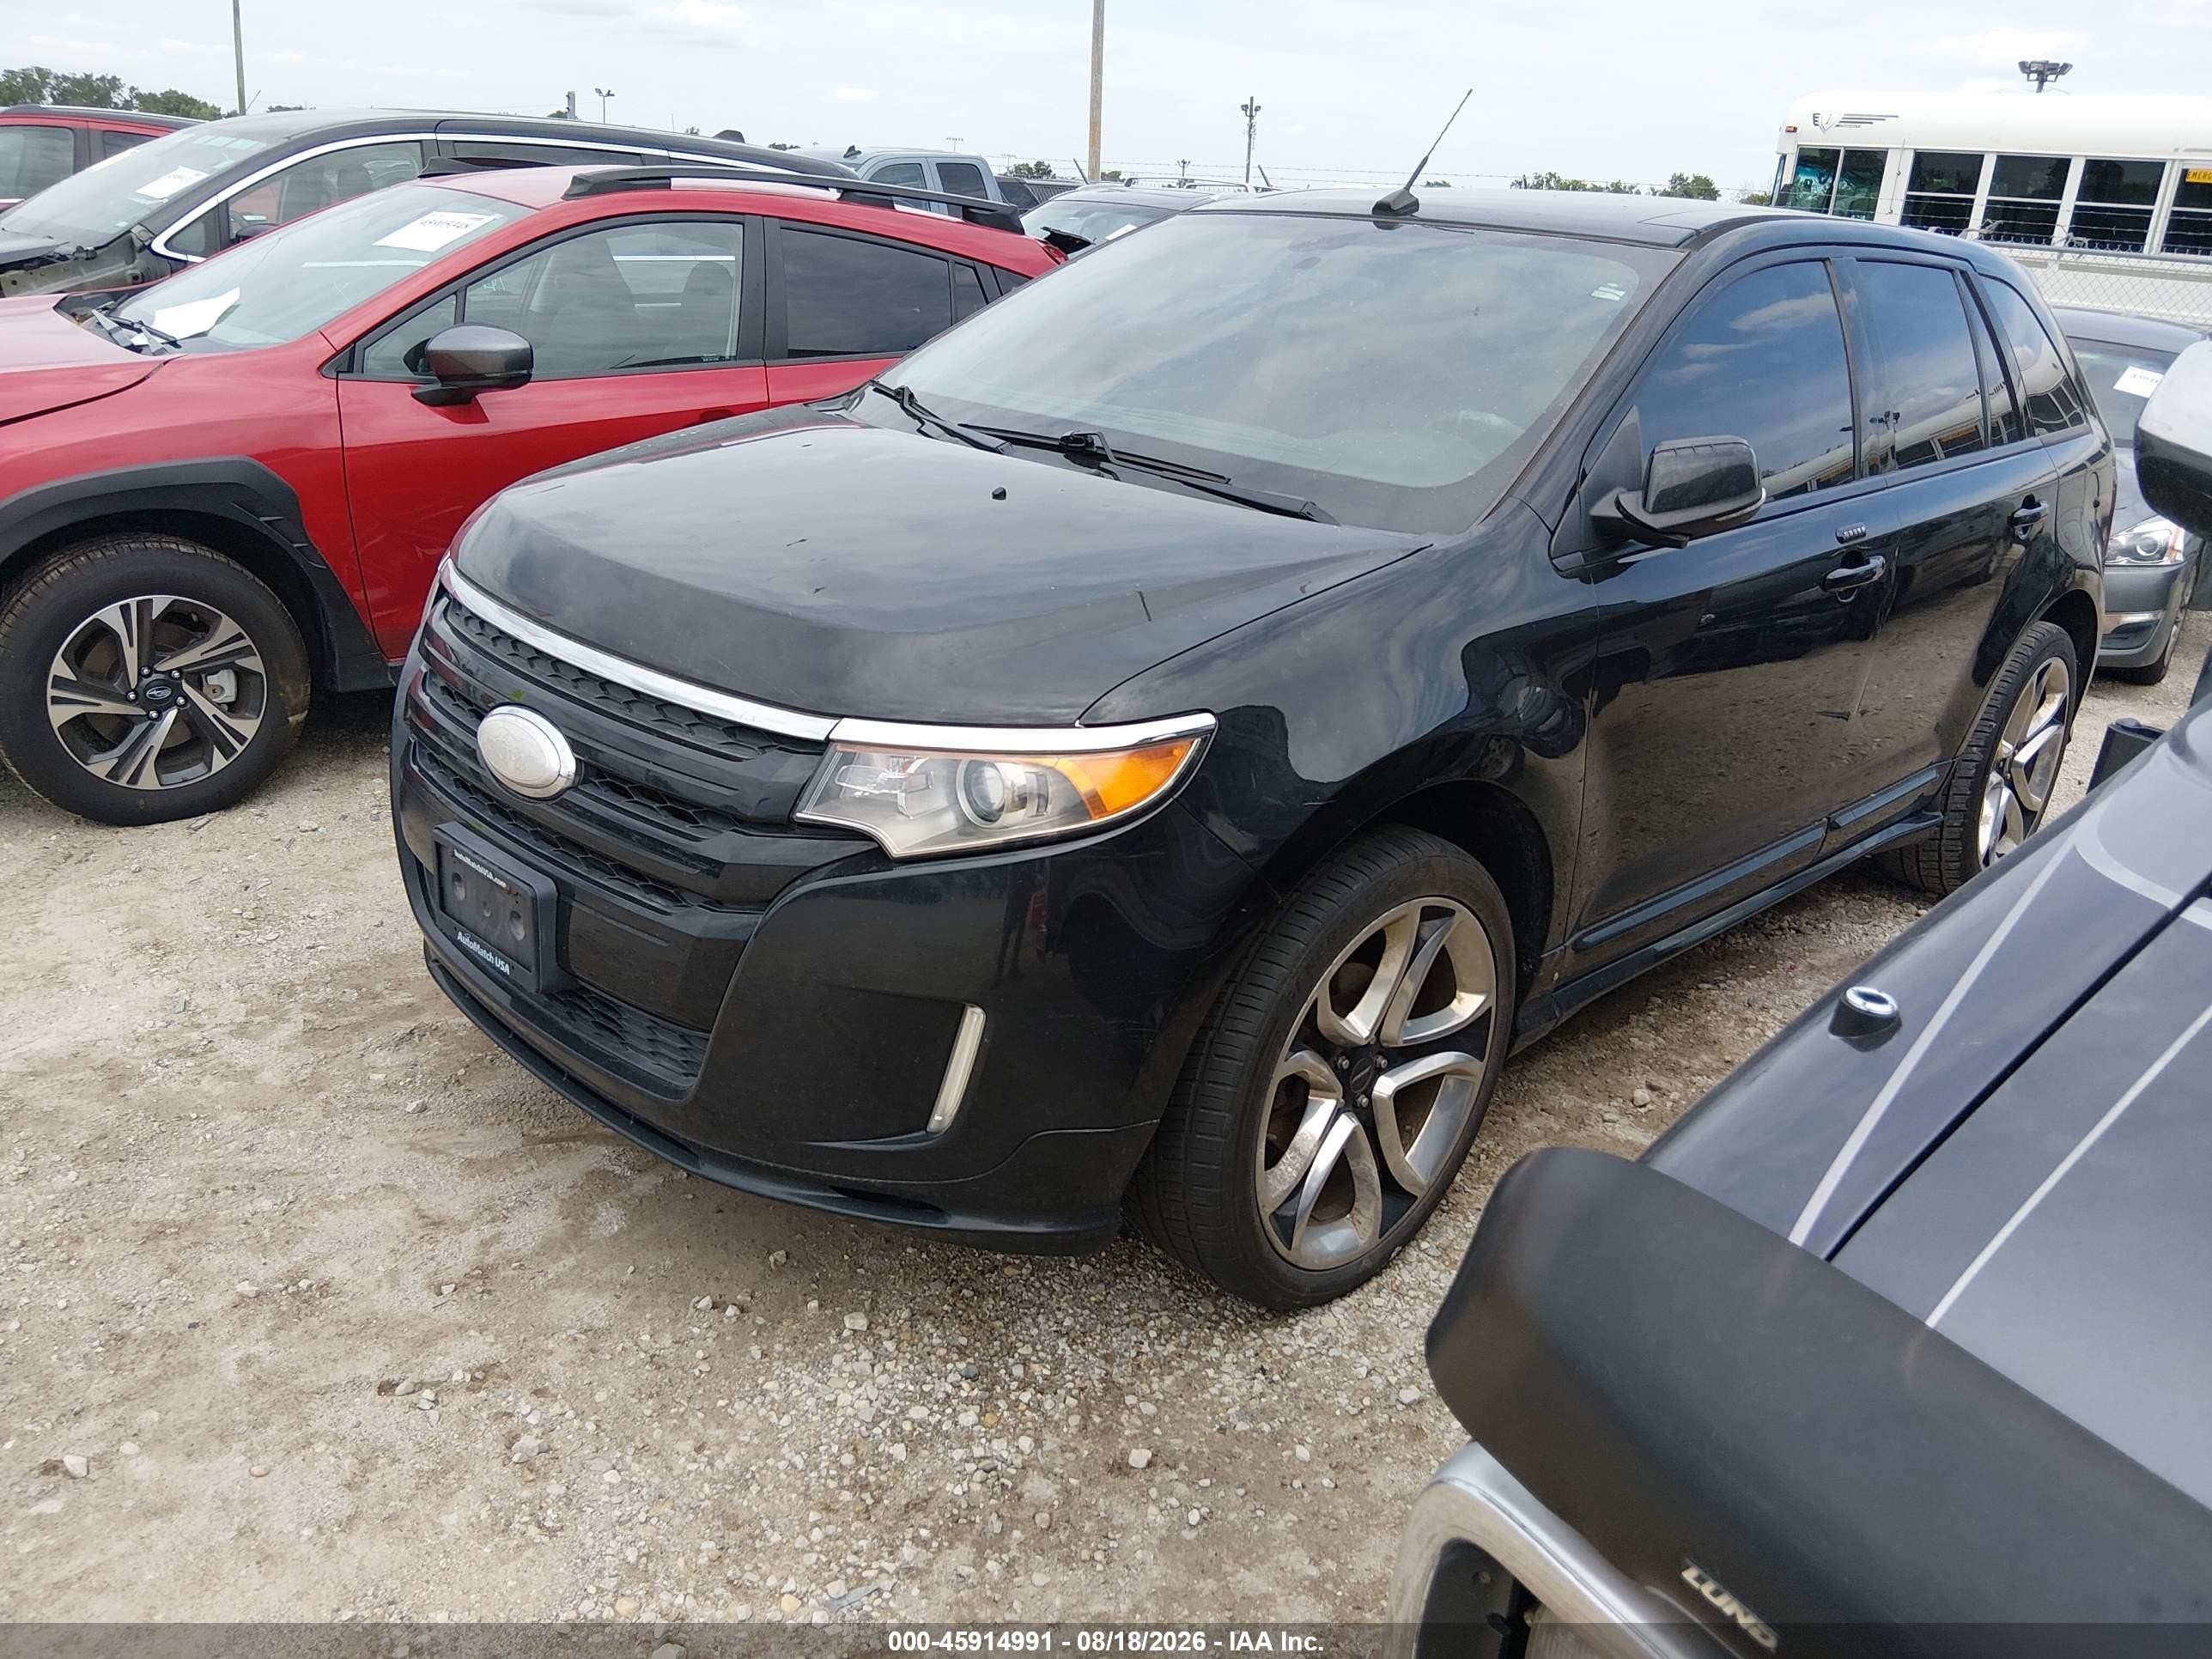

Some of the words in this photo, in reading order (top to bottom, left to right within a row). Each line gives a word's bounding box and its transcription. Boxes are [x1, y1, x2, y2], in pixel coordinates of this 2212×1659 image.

[457, 931, 495, 964] AutoMatch
[495, 956, 511, 975] USA
[1680, 1566, 1778, 1650] LUND
